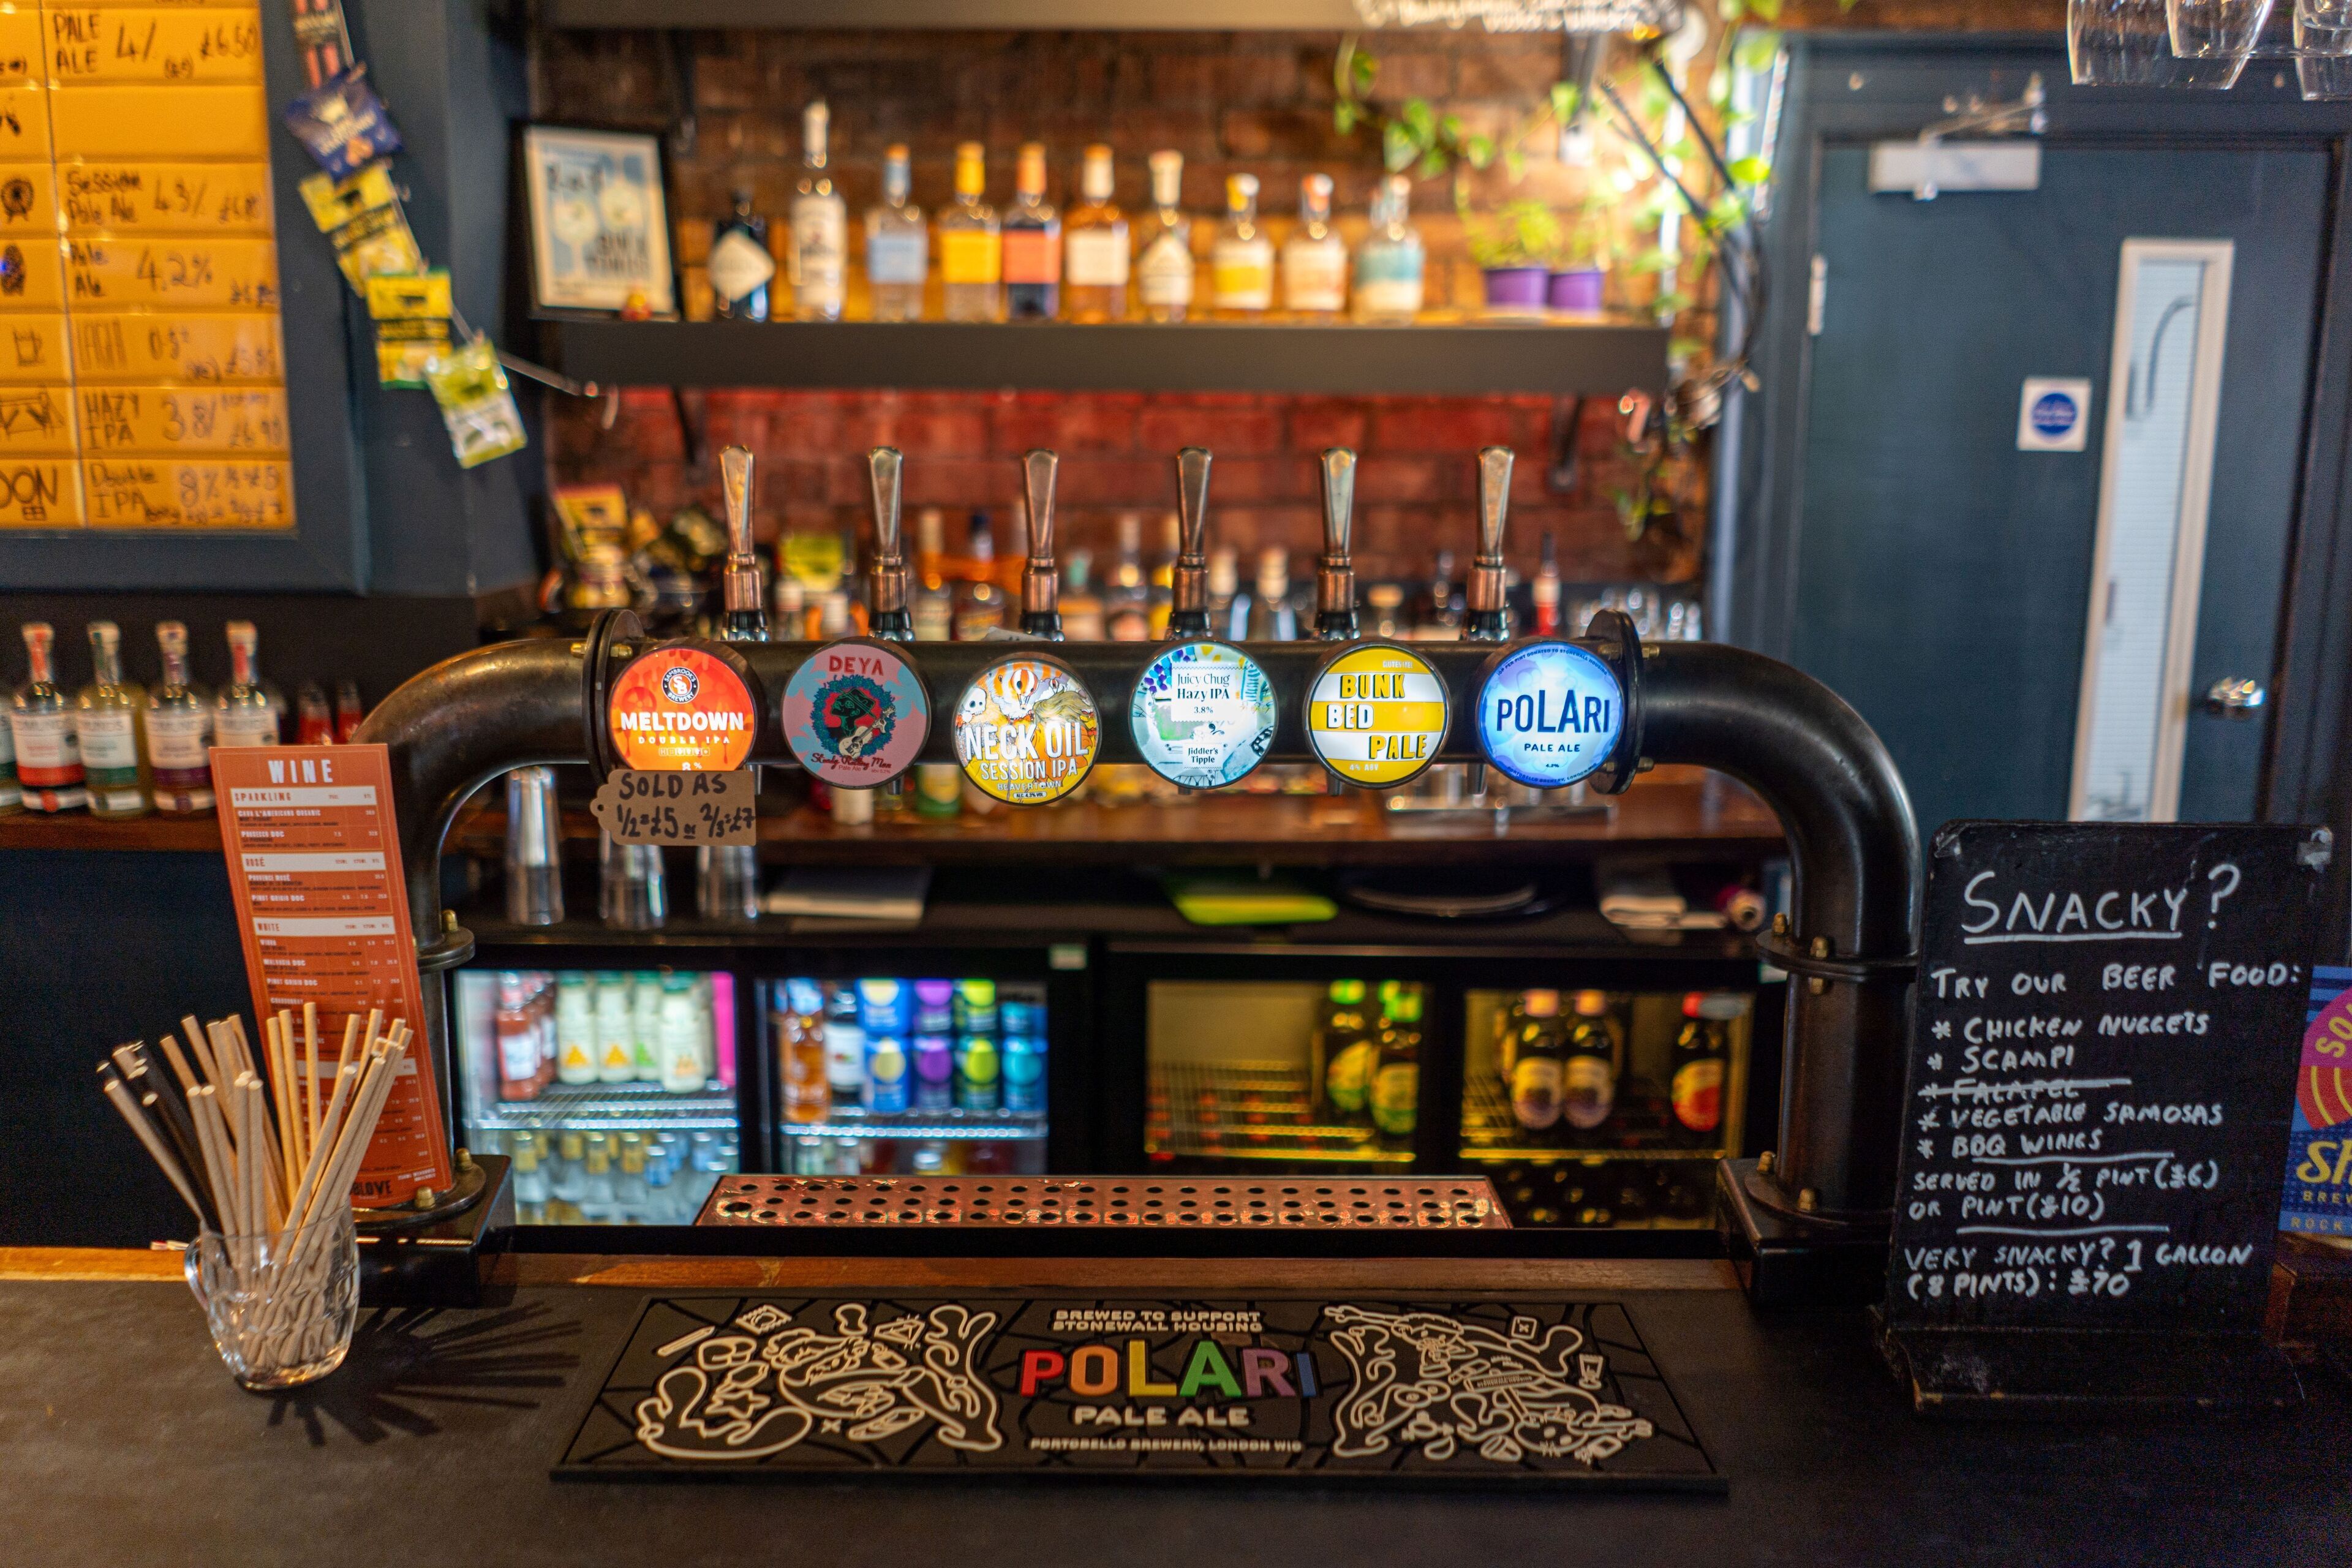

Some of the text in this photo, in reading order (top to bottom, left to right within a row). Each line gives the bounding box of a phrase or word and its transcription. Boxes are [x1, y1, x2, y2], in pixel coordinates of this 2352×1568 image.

[53, 13, 100, 43] PALE
[56, 48, 99, 74] ALE
[86, 423, 136, 450] IPA
[92, 490, 147, 518] IPA
[664, 668, 696, 682] SAMBROOK'S
[829, 655, 884, 676] DEYA
[1527, 649, 1551, 657] DONATED
[1560, 649, 1588, 662] STONEWALL
[1589, 658, 1608, 676] HOUSING
[1177, 673, 1231, 687] Juicy Chug
[1340, 674, 1405, 699] BUNK
[668, 692, 695, 702] BREWERY
[1177, 688, 1230, 702] Hazy IPA
[620, 711, 744, 731] MELTDOWN
[1327, 704, 1374, 729] BED
[1496, 690, 1610, 733] POLARI
[965, 722, 1089, 761] NECK OIL
[1188, 747, 1218, 756] Jiddler's
[1369, 735, 1427, 760] PALE
[1524, 744, 1580, 752] PALE ALE
[268, 759, 333, 784] WINE
[981, 758, 1078, 782] SESSION IPA
[1191, 755, 1215, 765] Tipple
[235, 793, 292, 802] SPARKLING
[619, 772, 728, 799] SOLD AS
[1931, 962, 2301, 998] TRY OUR BEER FOOD:
[1963, 1012, 2210, 1043] CHICKEN NUGGETS
[1961, 1044, 2075, 1074] SCAMPI
[1950, 1101, 2223, 1129] VEGETABLE SAMOSAS
[1952, 1128, 2103, 1158] BBQ WINGS
[1913, 1171, 1996, 1192] SERVED
[2015, 1170, 2041, 1191] IN
[1909, 1200, 1942, 1221] OR
[1904, 1237, 2254, 1272] VERY SNACKY? 1 GALLON
[1052, 1321, 1264, 1333] STONEWALL HOUSING
[1055, 1310, 1262, 1322] BREWED TO SUPPORT
[1020, 1339, 1317, 1398] POLARI
[1074, 1406, 1250, 1427] PALE ALE
[1030, 1438, 1127, 1451] PORTOBELLO
[1130, 1438, 1205, 1452] BREWERY,
[1208, 1439, 1271, 1452] LONDON
